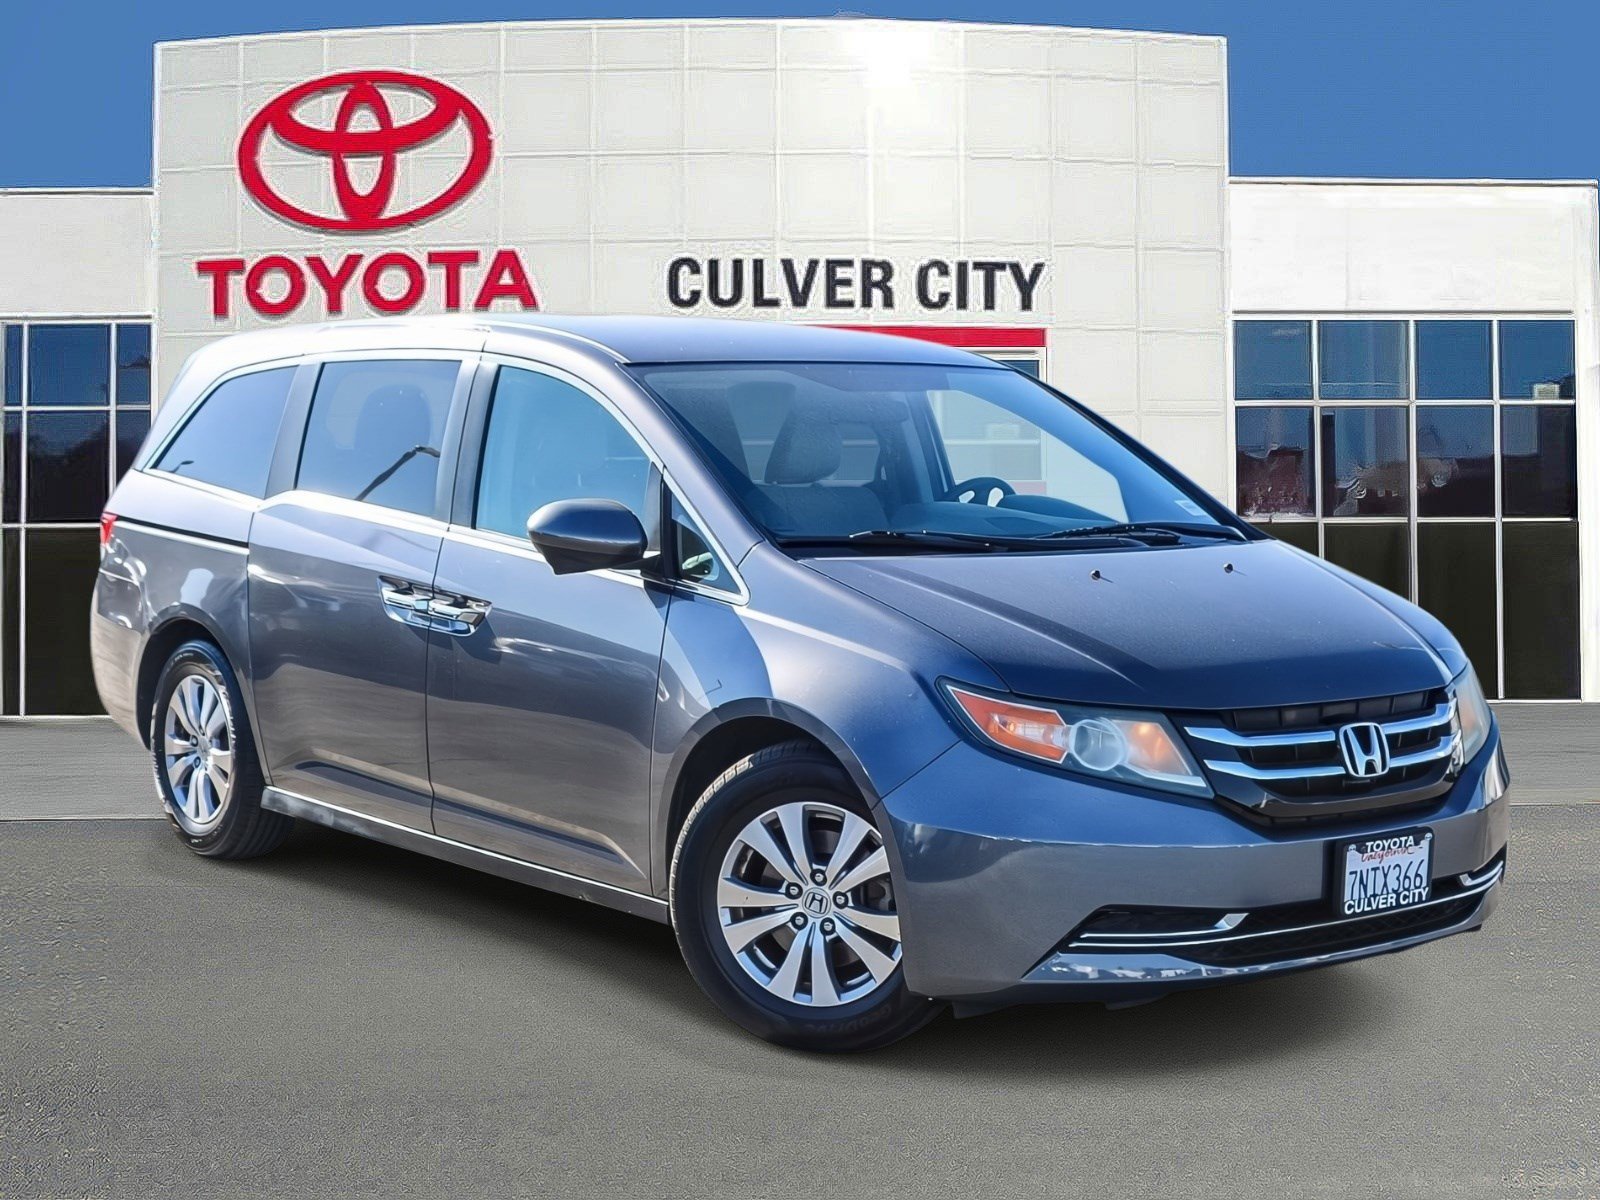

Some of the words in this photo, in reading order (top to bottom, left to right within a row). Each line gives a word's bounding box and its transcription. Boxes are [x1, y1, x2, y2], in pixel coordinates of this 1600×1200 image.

[196, 249, 538, 318] TOYOTA
[667, 257, 894, 309] CULVER
[916, 259, 1046, 311] CITY
[1365, 836, 1414, 853] TOYOTA
[1349, 859, 1425, 900] 7NTX366
[1344, 893, 1397, 914] CULVER
[1400, 887, 1429, 905] CITY
